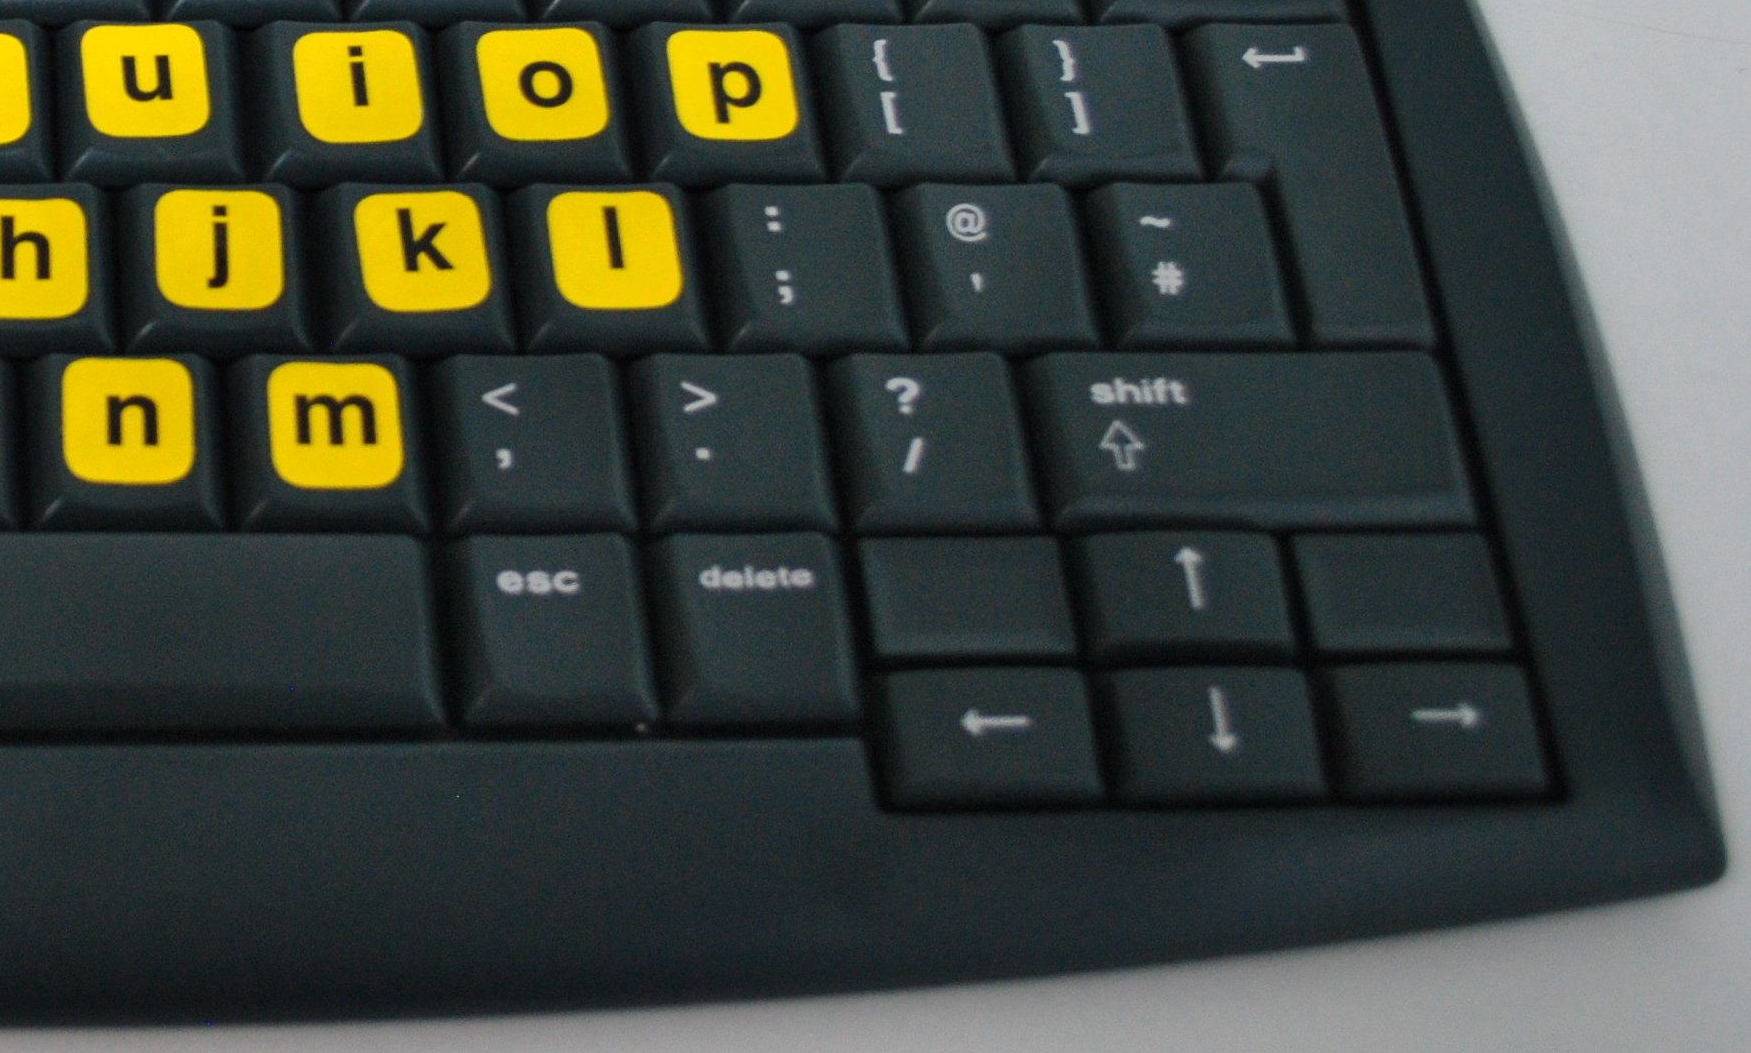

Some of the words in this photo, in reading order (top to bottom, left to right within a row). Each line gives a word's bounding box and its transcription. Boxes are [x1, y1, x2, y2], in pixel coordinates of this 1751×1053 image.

[121, 54, 174, 103] u
[348, 45, 370, 107] i
[872, 38, 895, 82] {
[1052, 39, 1076, 82] }
[518, 60, 574, 109] o
[708, 61, 763, 125] p
[880, 91, 904, 135] [
[1067, 91, 1091, 135] ]
[396, 207, 454, 273] k
[764, 206, 782, 232] :
[945, 202, 988, 243] @
[0, 215, 52, 281] h
[207, 205, 230, 289] j
[775, 270, 794, 305] ;
[1152, 261, 1184, 295] #
[481, 383, 519, 415] <
[680, 381, 718, 413] >
[885, 376, 921, 415] ?
[1090, 377, 1187, 405] shift
[106, 394, 159, 447] n
[294, 394, 378, 446] m
[903, 437, 924, 474] /
[496, 570, 580, 595] esc
[699, 565, 813, 590] delete
